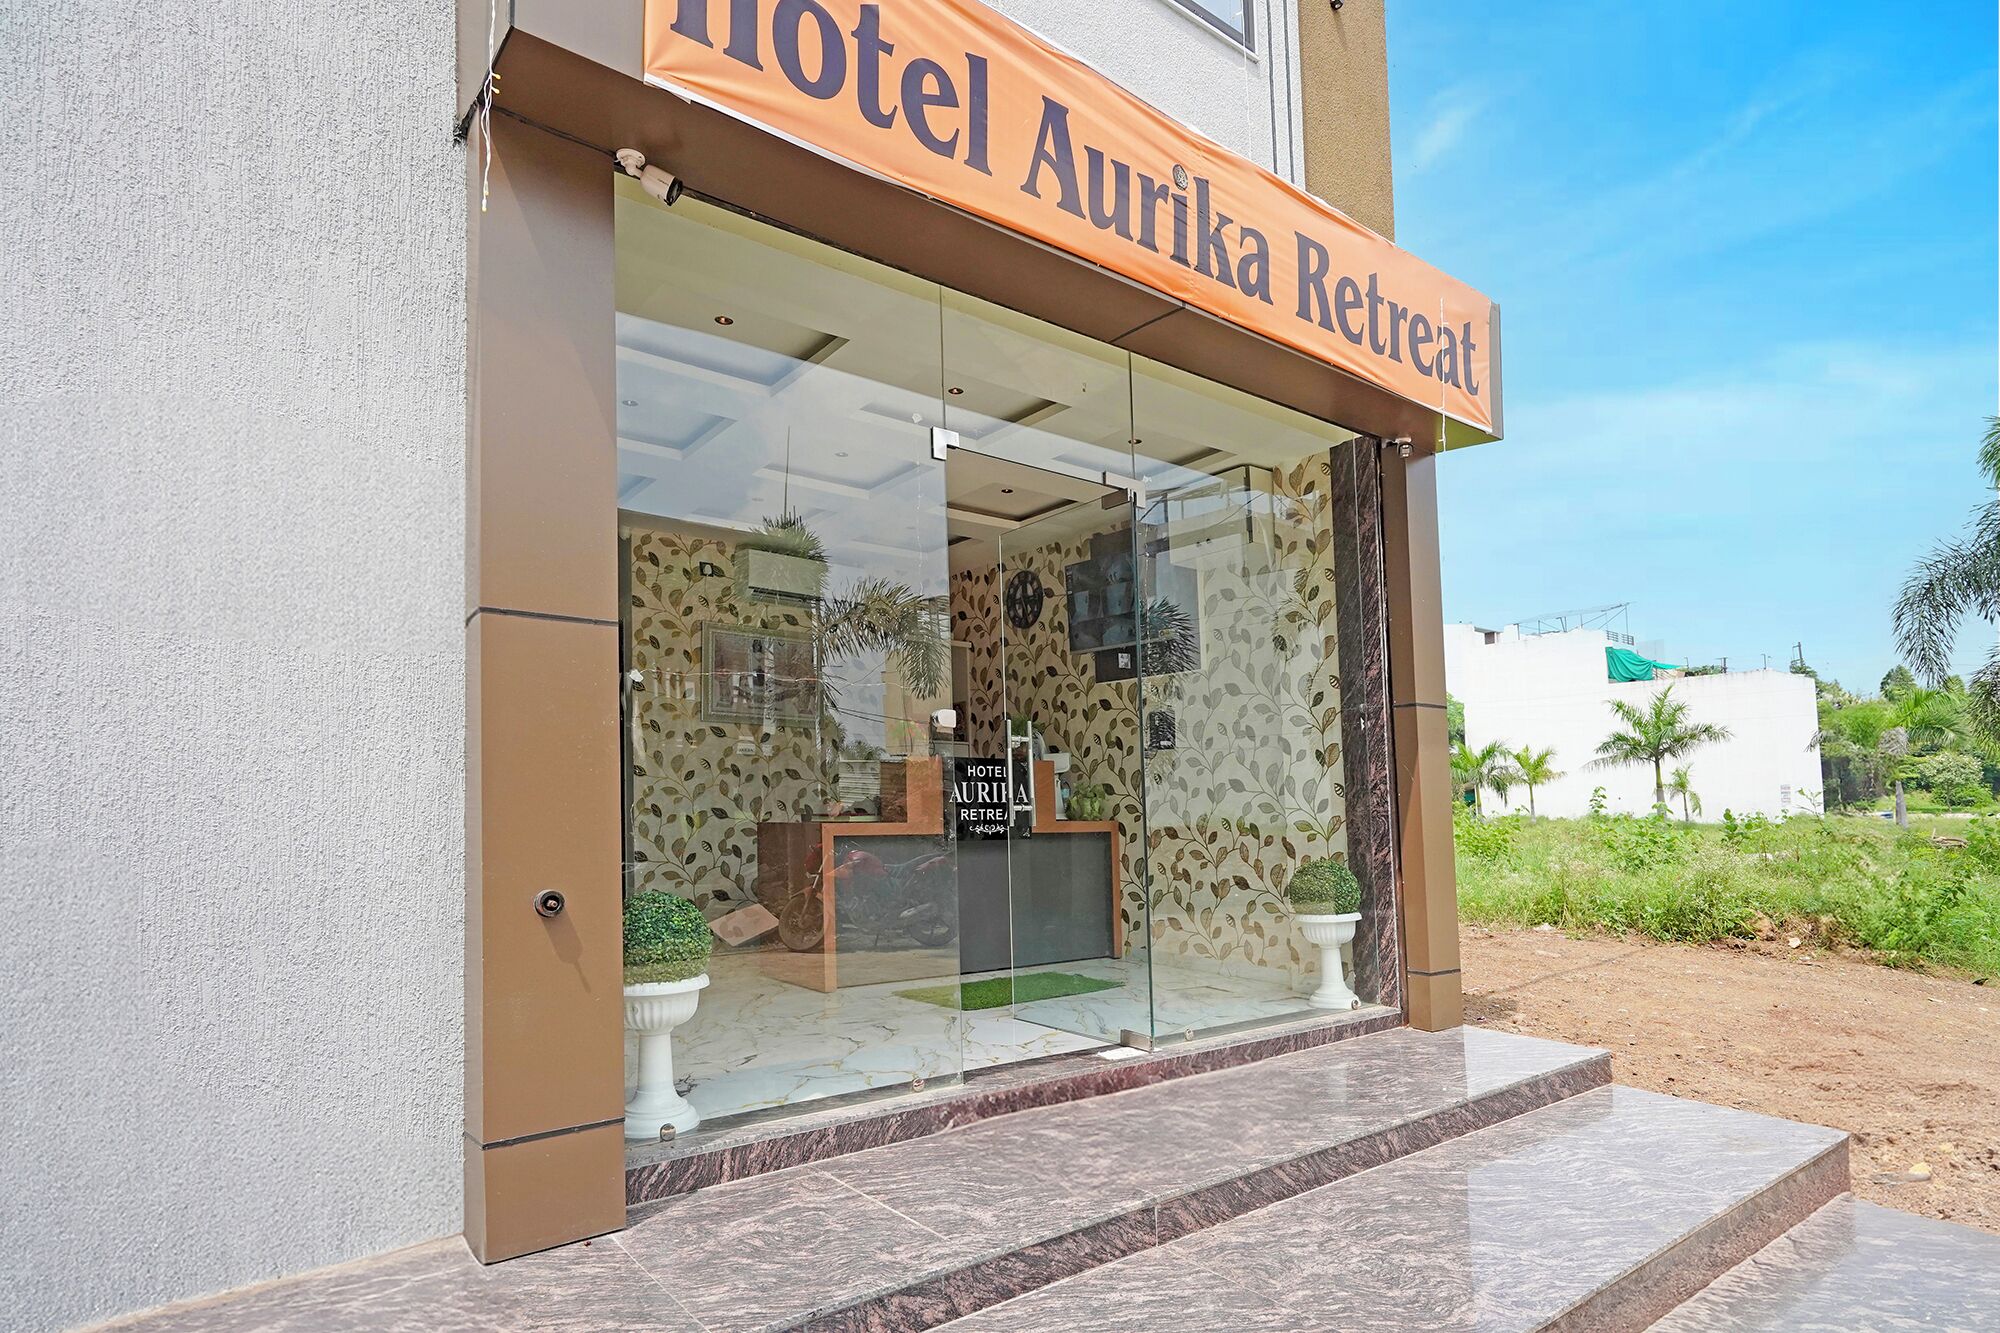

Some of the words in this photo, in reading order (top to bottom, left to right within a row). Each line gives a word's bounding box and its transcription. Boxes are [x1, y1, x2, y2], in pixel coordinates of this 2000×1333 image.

[1020, 95, 1274, 306] Aurika
[1294, 230, 1480, 396] Retreat
[960, 808, 1015, 821] RETRE
